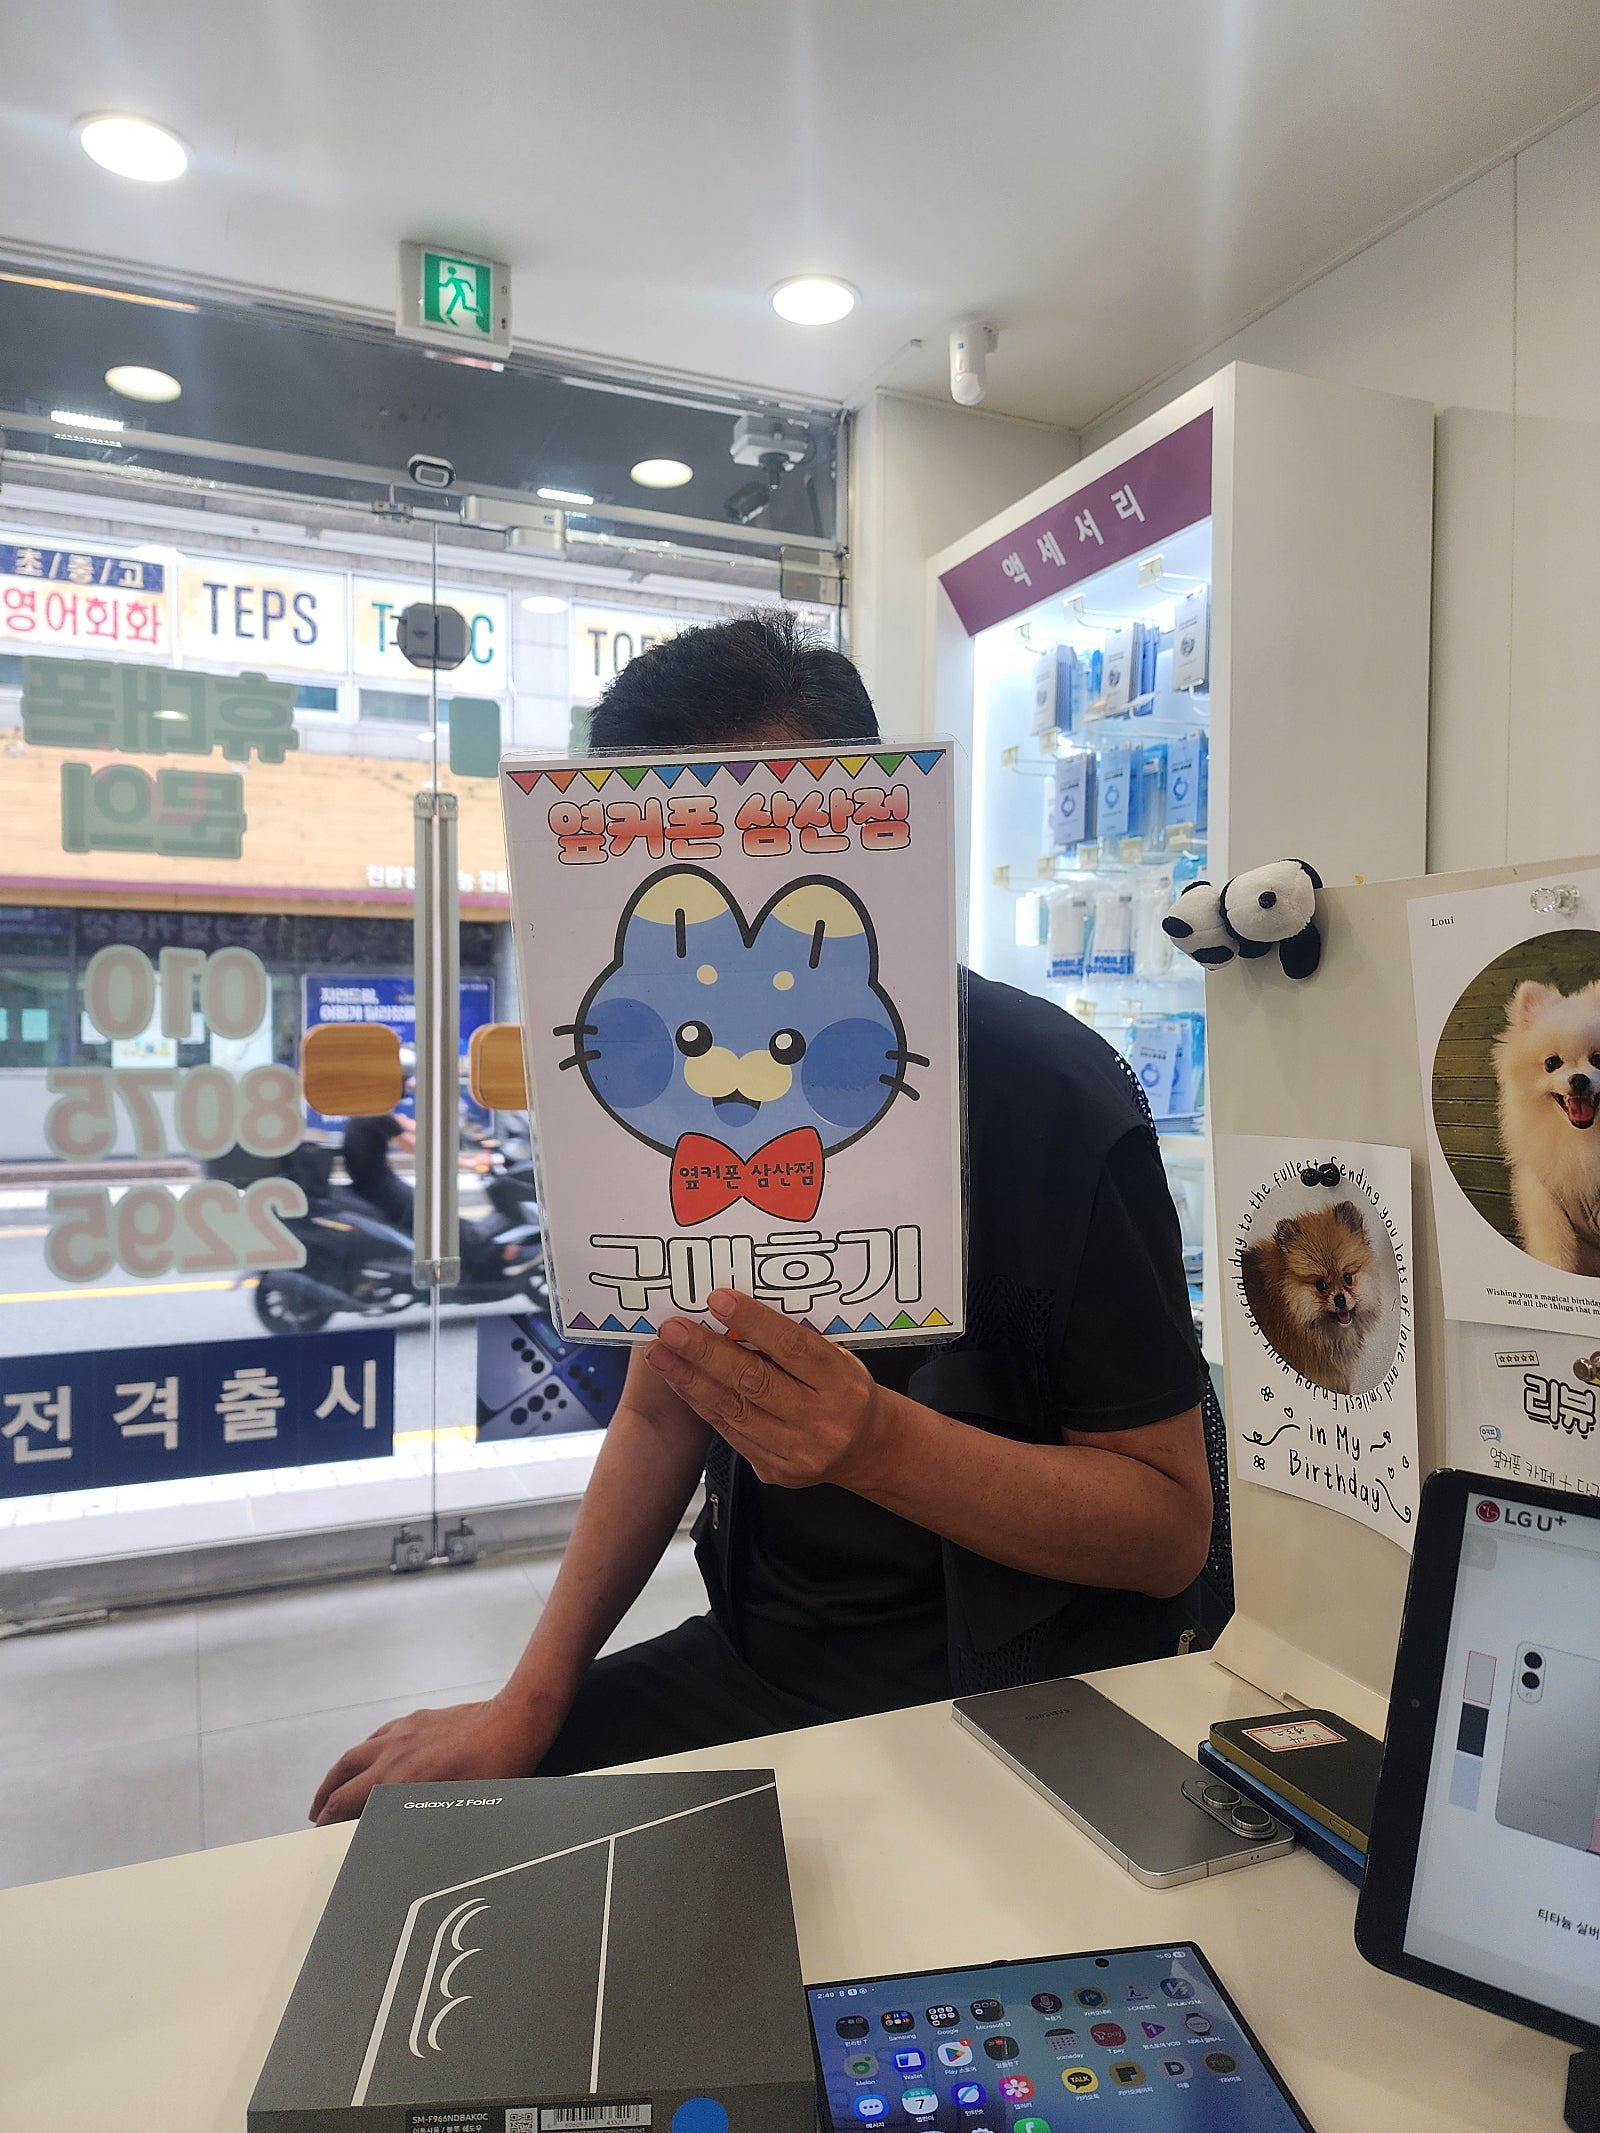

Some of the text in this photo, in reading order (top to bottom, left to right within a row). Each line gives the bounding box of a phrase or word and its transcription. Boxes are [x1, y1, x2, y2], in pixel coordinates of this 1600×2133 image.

[3, 587, 162, 645] 영어회화
[202, 580, 319, 646] TEPS
[547, 784, 912, 865] 옆커폰 삼산점
[1431, 916, 1455, 927] Loui
[679, 1161, 814, 1190] 옆커폰 삼산점
[1249, 1183, 1271, 1210] the
[1238, 1213, 1253, 1232] to
[1379, 1207, 1398, 1237] you
[1228, 1237, 1248, 1268] day
[1394, 1243, 1408, 1284] lots
[589, 1224, 922, 1314] 구매후기
[1232, 1275, 1262, 1335] special
[1400, 1294, 1411, 1317] of
[1486, 1287, 1518, 1299] Wishing
[1540, 1294, 1570, 1303] magical
[1523, 1299, 1534, 1307] all
[1535, 1301, 1549, 1309] the
[1550, 1302, 1575, 1312] things
[1575, 1305, 1591, 1315] that
[1263, 1341, 1293, 1375] your
[1397, 1323, 1412, 1362] love
[1295, 1371, 1338, 1411] Enjoy
[1383, 1365, 1399, 1401] and
[1523, 1373, 1597, 1440] 리뷰
[1307, 1417, 1360, 1461] in My
[1289, 1448, 1380, 1513] Birthday
[1525, 1461, 1555, 1487] 카페
[403, 1798, 503, 1809] Galaxy Z Fold7
[1538, 1908, 1600, 1941] 티타늄 실버
[975, 2022, 1004, 2030] Microsoft
[1056, 2052, 1084, 2060] someday
[915, 2099, 925, 2109] 7
